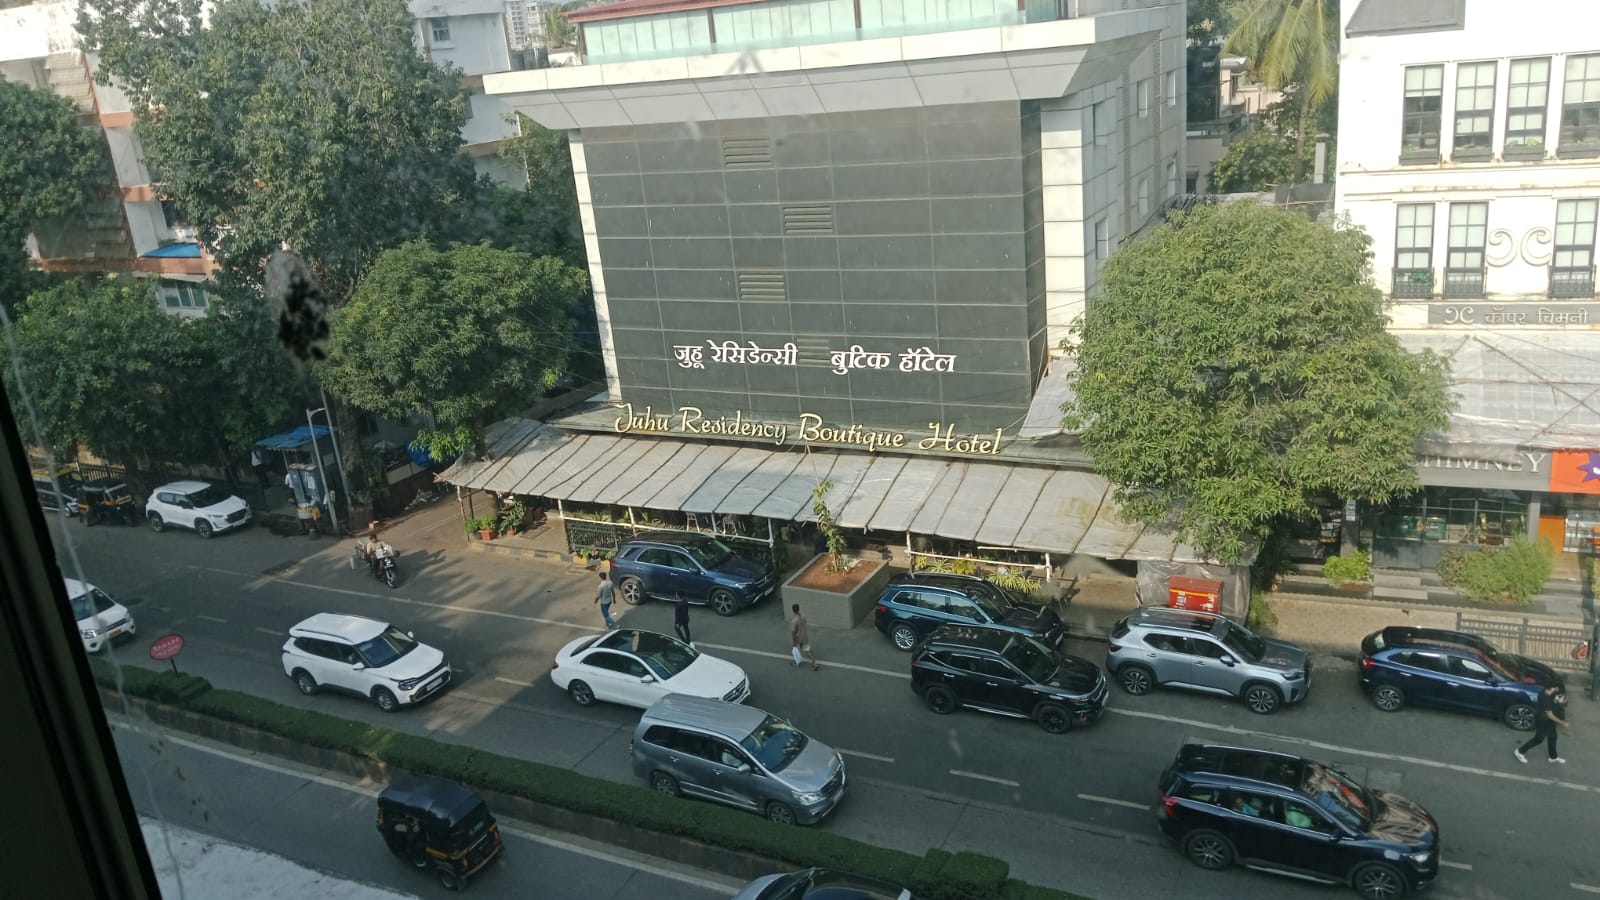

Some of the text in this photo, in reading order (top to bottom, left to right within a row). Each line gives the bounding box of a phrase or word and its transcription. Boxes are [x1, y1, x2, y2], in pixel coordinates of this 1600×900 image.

[1537, 307, 1589, 325] चिमनी
[673, 339, 958, 375] जुहू रेसिडेन्सी बुटिक हॉटेल
[614, 402, 1004, 455] Juhu Residency Boutique Hotel
